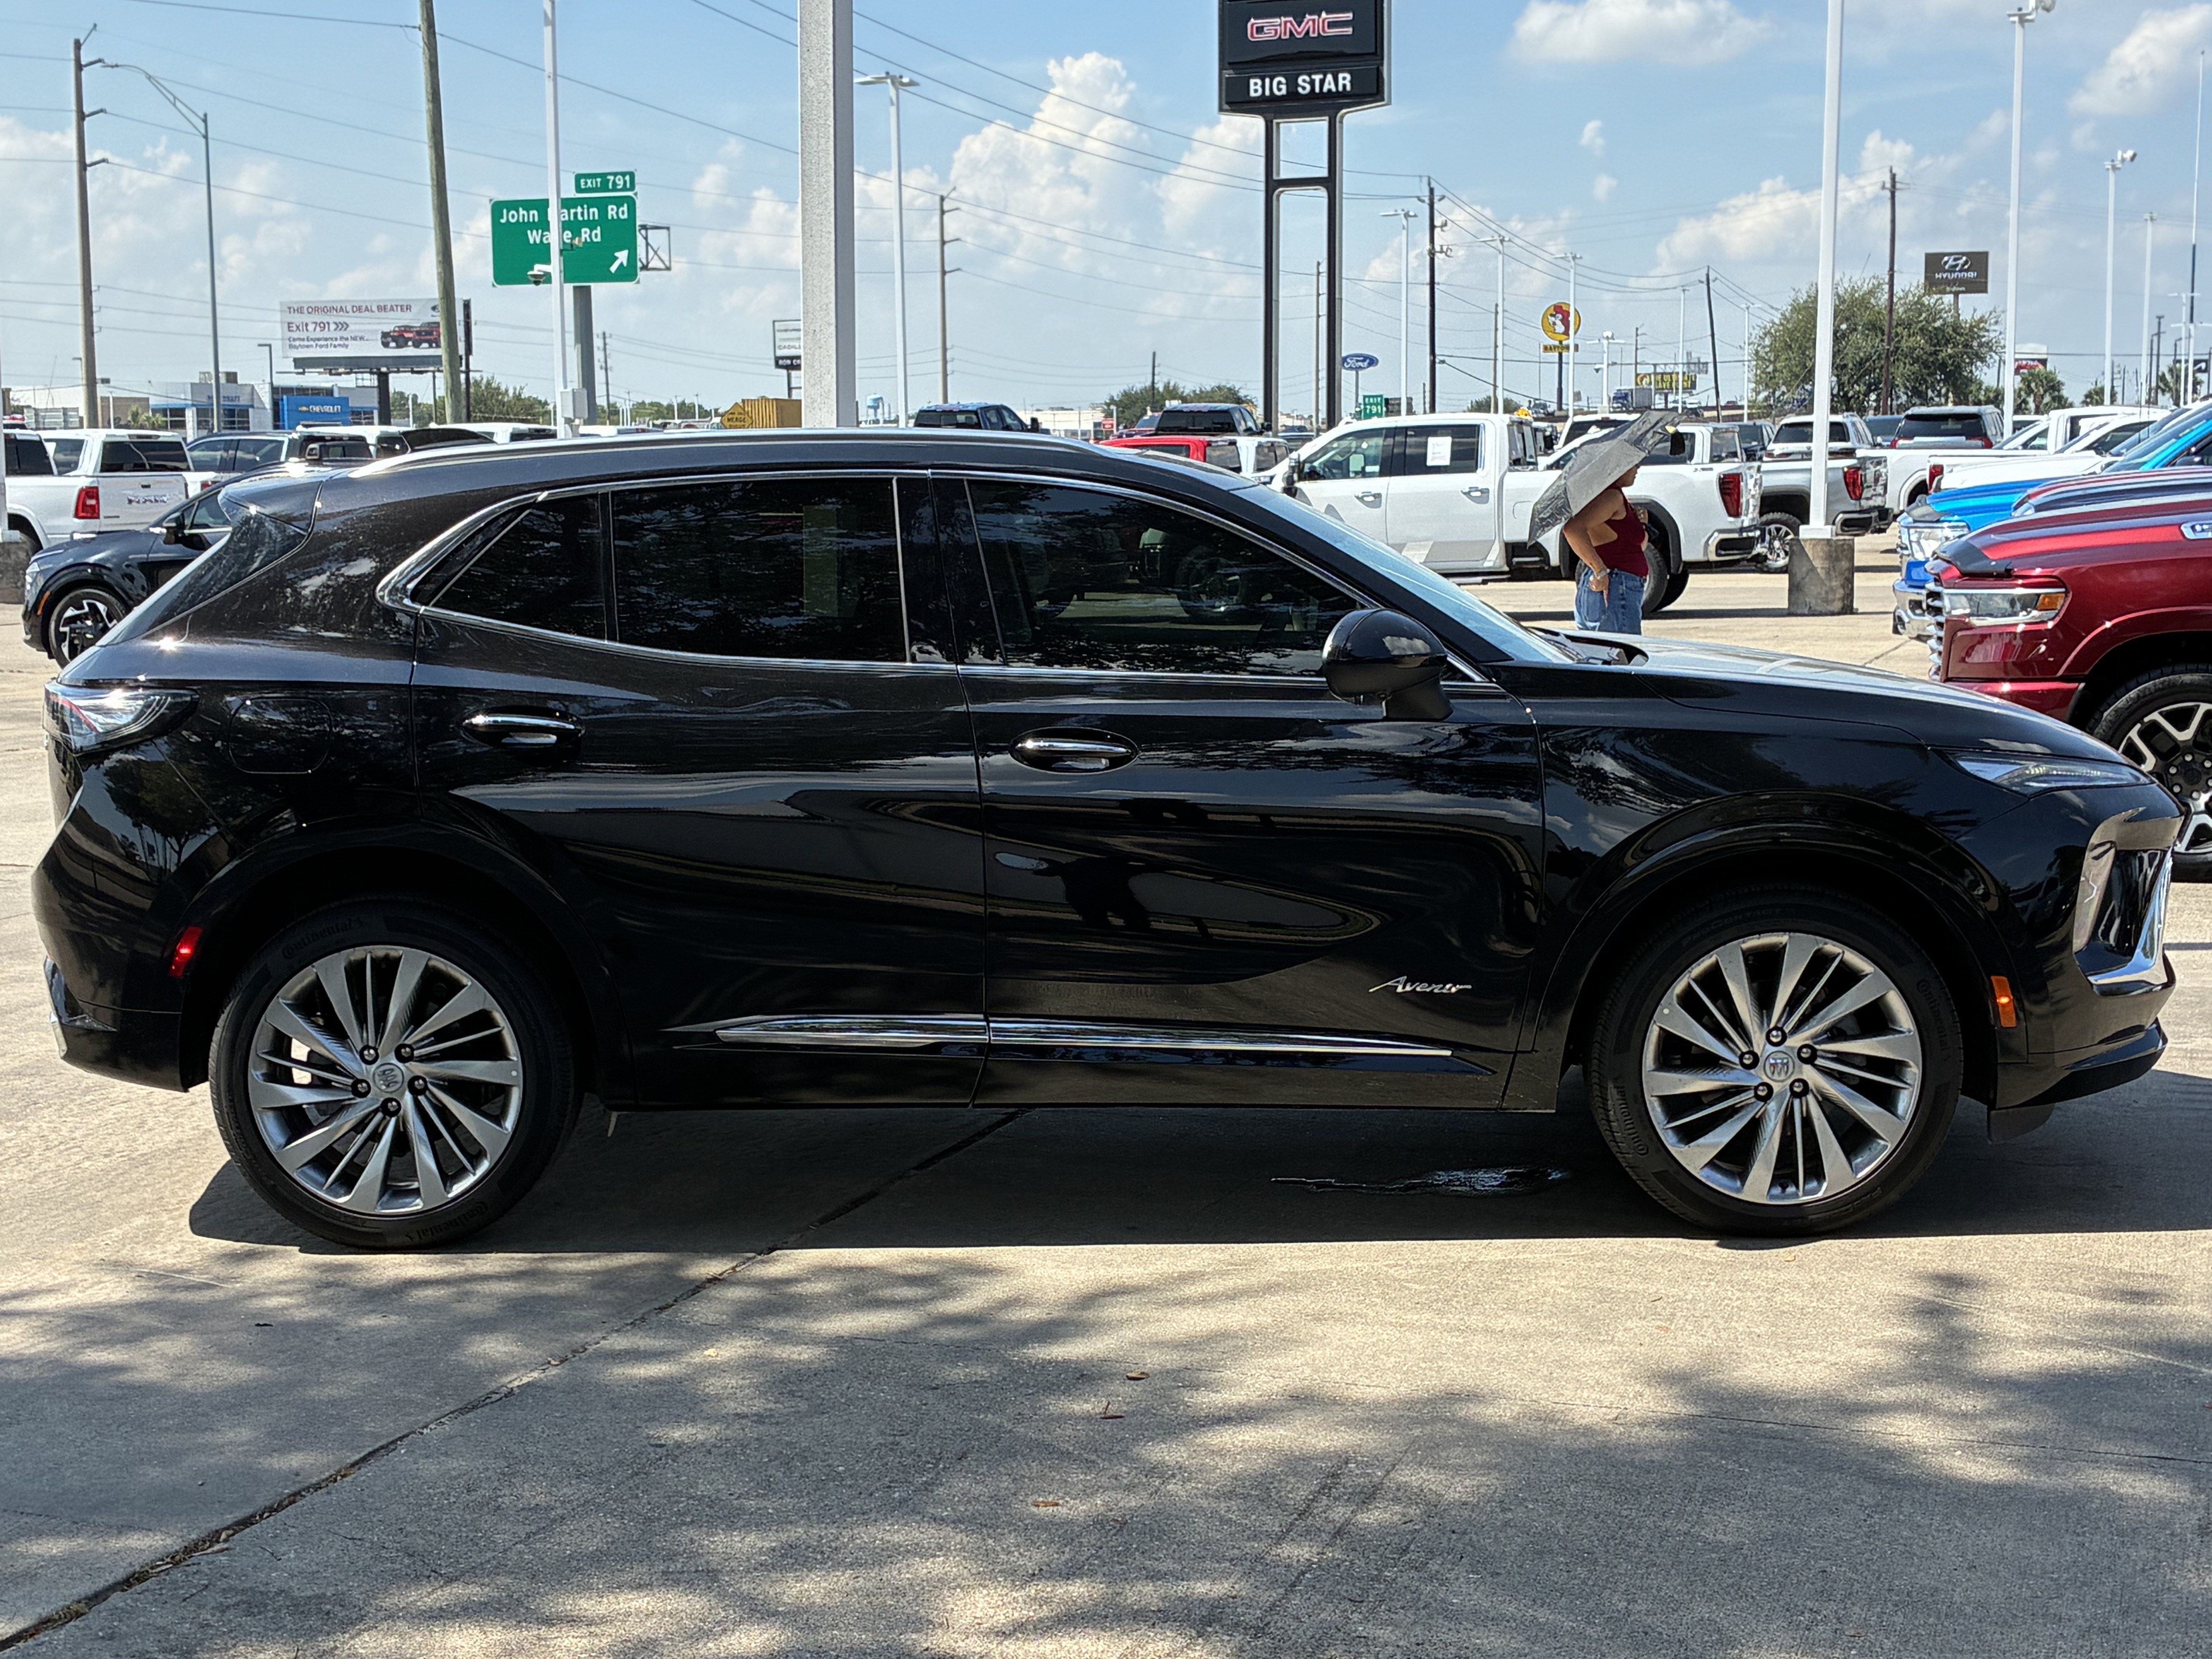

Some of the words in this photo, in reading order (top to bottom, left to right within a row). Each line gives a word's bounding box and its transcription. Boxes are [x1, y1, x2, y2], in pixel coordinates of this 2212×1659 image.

[1247, 10, 1353, 41] GMC
[1249, 77, 1287, 97] BIG
[1297, 73, 1352, 94] STAR
[580, 178, 601, 188] EXIT
[607, 175, 630, 189] 791
[500, 207, 539, 223] John
[548, 204, 599, 222] artin
[608, 203, 628, 220] Rd
[527, 229, 572, 244] Wae
[582, 226, 601, 242] Rd
[1935, 271, 1977, 280] HYUNDAI
[287, 306, 305, 314] THE
[306, 305, 350, 315] ORIGINAL
[352, 305, 375, 313] DEAL
[377, 304, 412, 313] BEATER
[287, 321, 309, 332] Exit
[311, 321, 330, 332] 791
[1344, 357, 1370, 368] Ford
[1365, 405, 1381, 414] 791
[1368, 975, 1472, 993] Avenir
